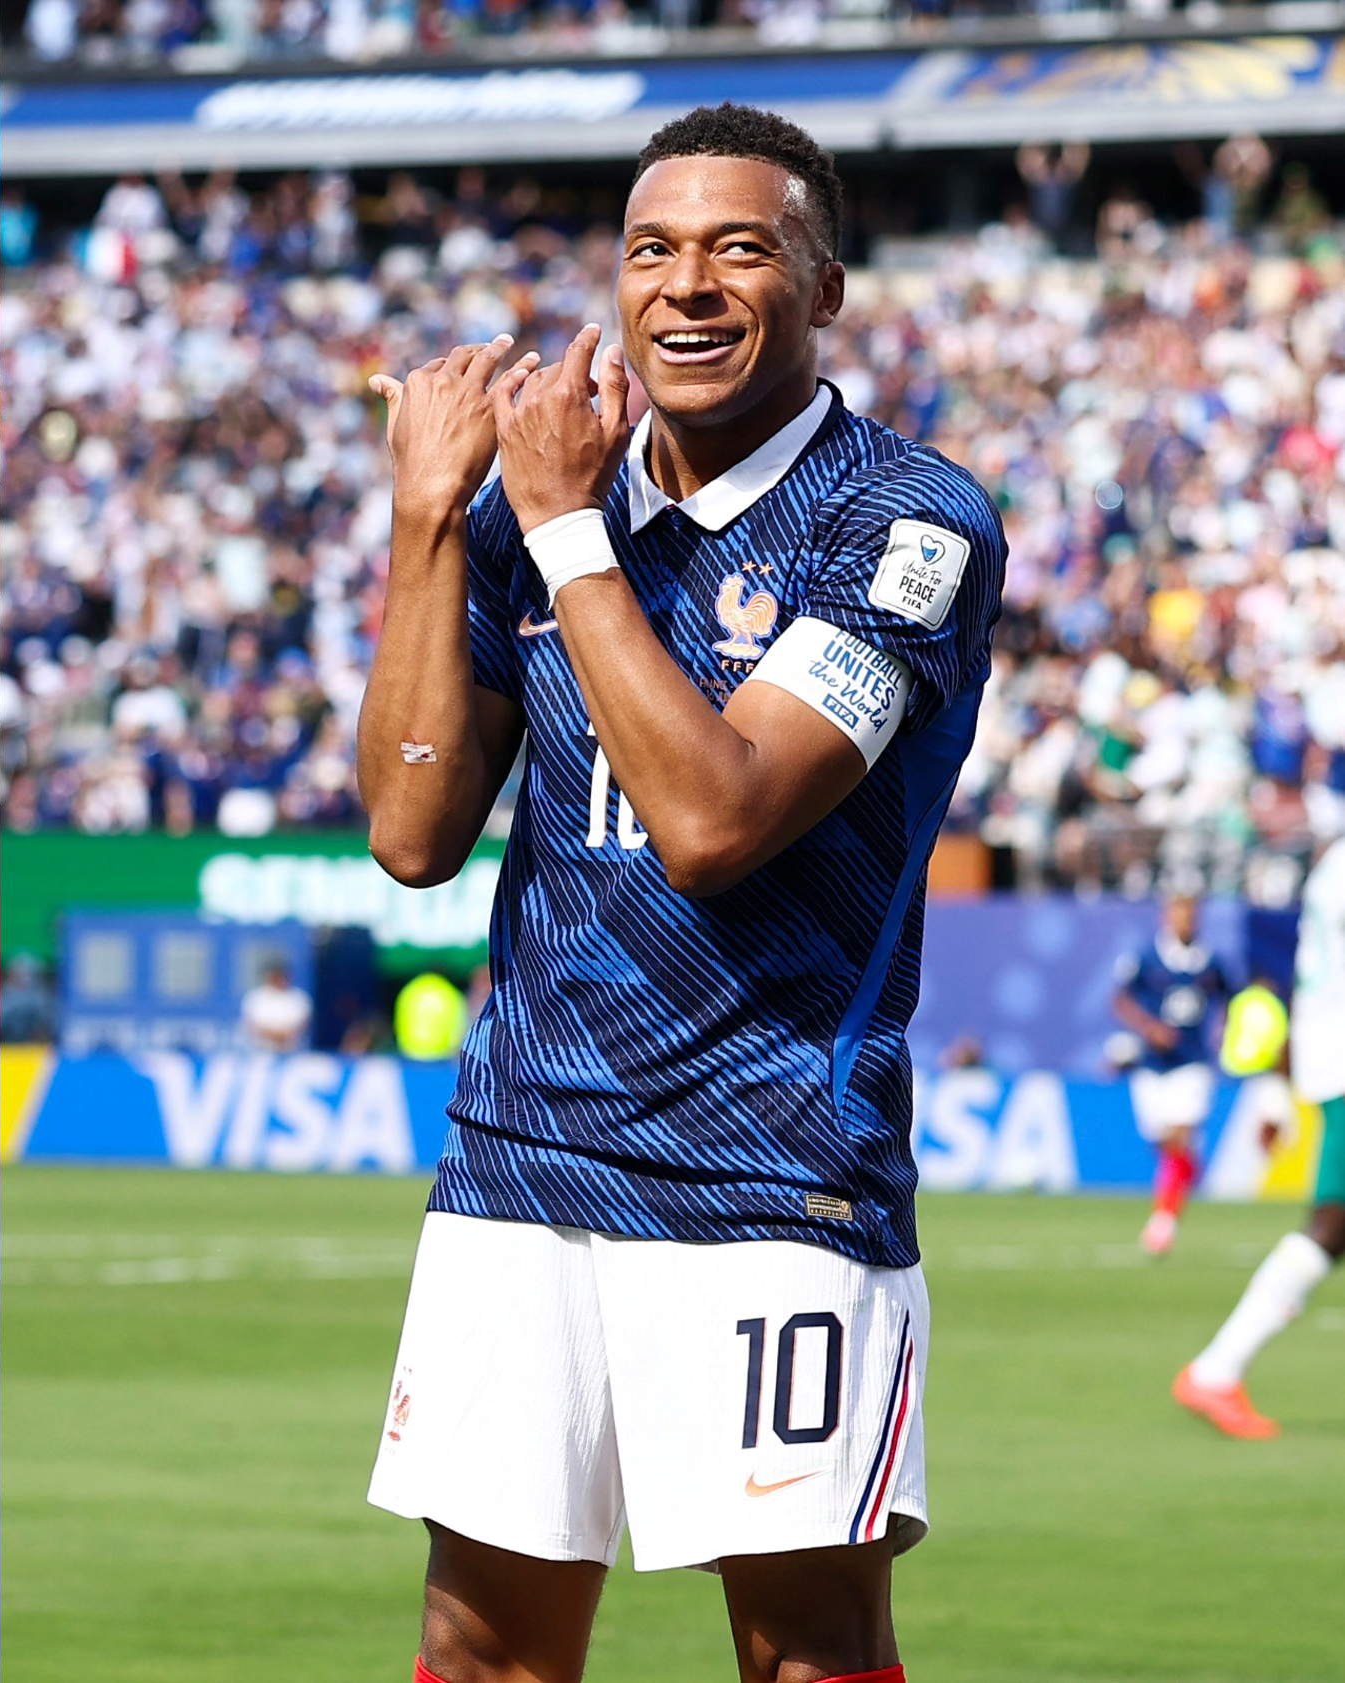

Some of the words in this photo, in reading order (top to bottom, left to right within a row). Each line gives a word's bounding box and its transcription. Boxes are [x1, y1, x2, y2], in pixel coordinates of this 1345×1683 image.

[899, 576, 936, 604] PEACE
[902, 559, 928, 579] Unite
[929, 570, 943, 586] For
[902, 595, 922, 610] FIFA
[823, 640, 895, 711] UNITES
[835, 629, 903, 691] FOOTBALL
[808, 660, 839, 688] the
[840, 680, 888, 734] World
[822, 693, 859, 730] FIFA
[133, 1050, 416, 1174] VISA
[913, 1067, 1082, 1194] SA
[736, 1311, 844, 1450] 10
